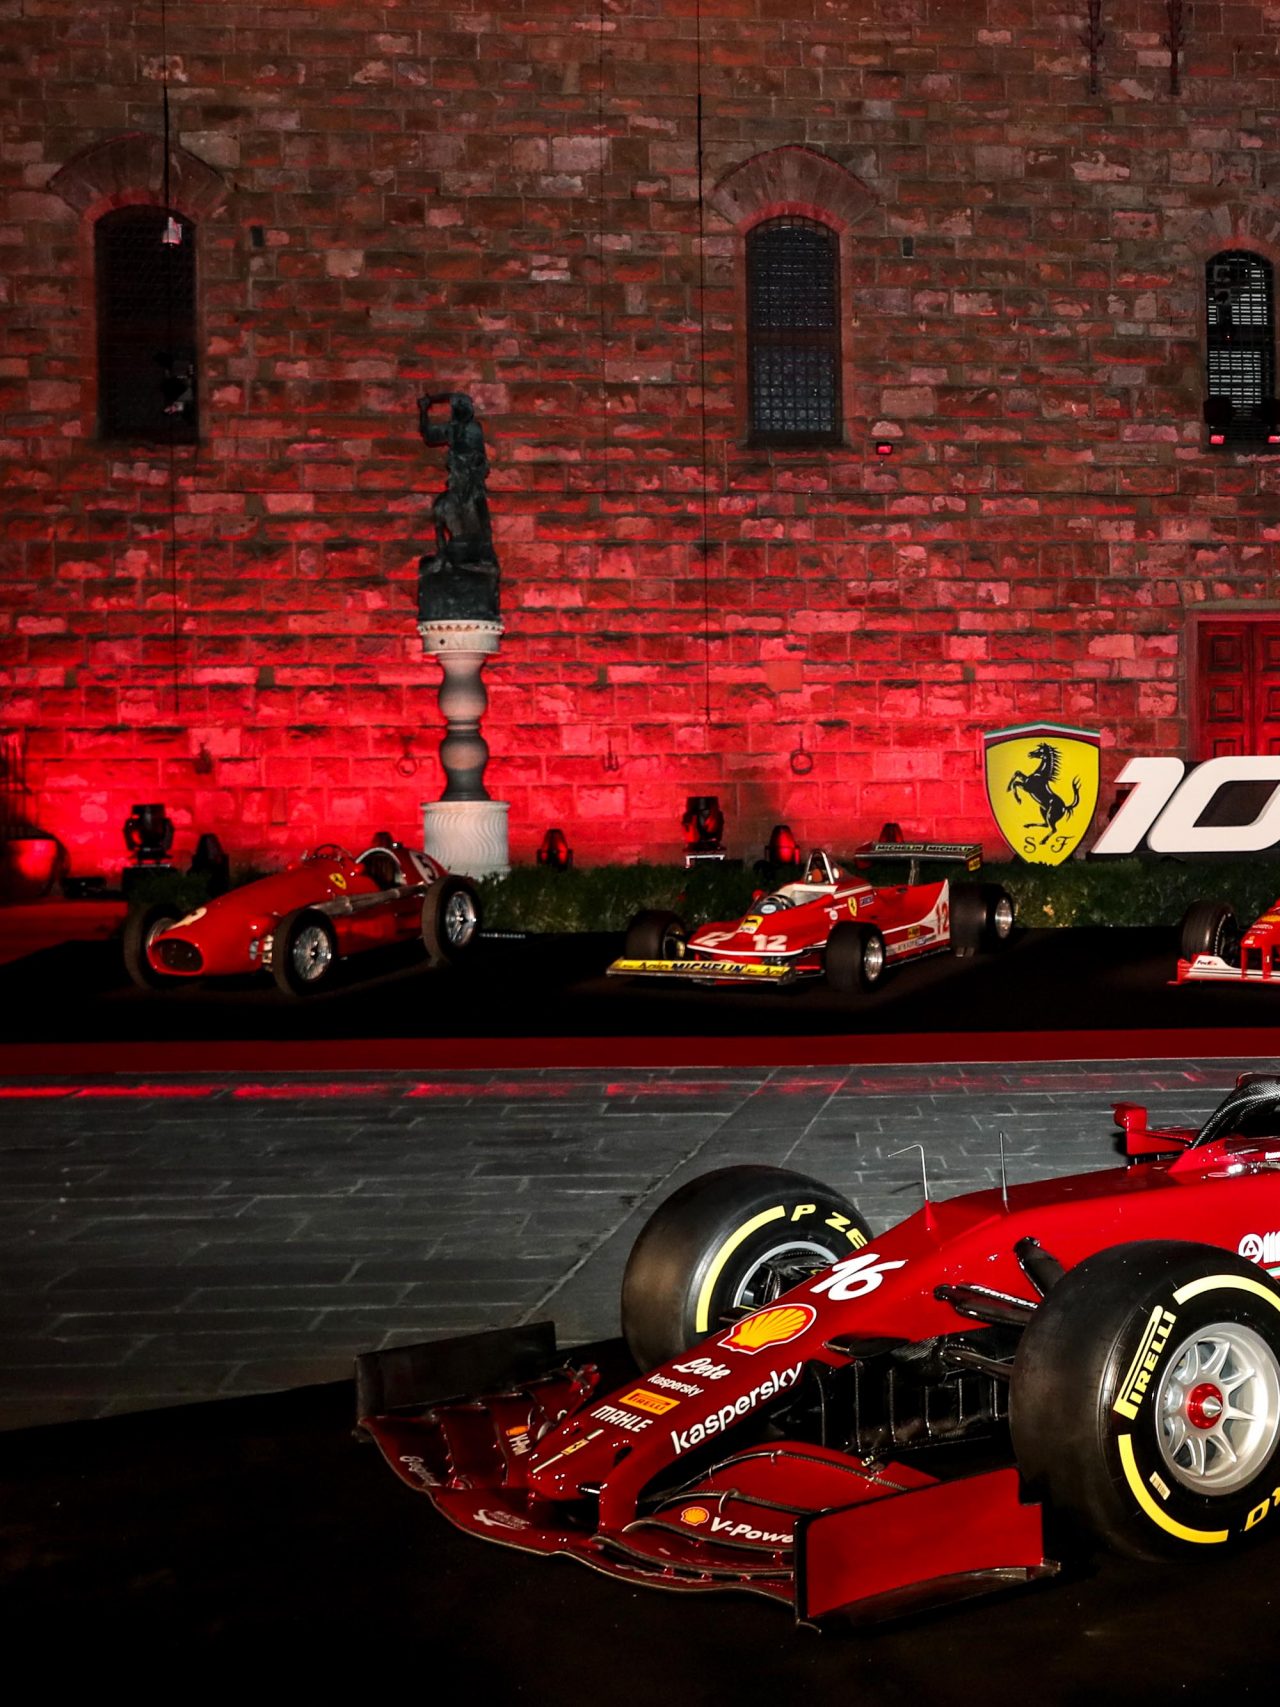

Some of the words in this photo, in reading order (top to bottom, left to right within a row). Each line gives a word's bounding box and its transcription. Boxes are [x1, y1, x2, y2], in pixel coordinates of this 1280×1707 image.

[752, 934, 788, 951] 12
[670, 962, 745, 973] MICHELIN
[791, 1203, 816, 1222] P
[809, 1252, 909, 1301] 16
[1112, 1304, 1177, 1420] PIRELLI
[647, 1372, 705, 1398] kaspersky
[590, 1404, 654, 1434] MAHLE
[670, 1360, 803, 1456] kaspersky
[710, 1516, 794, 1544] V-Powe
